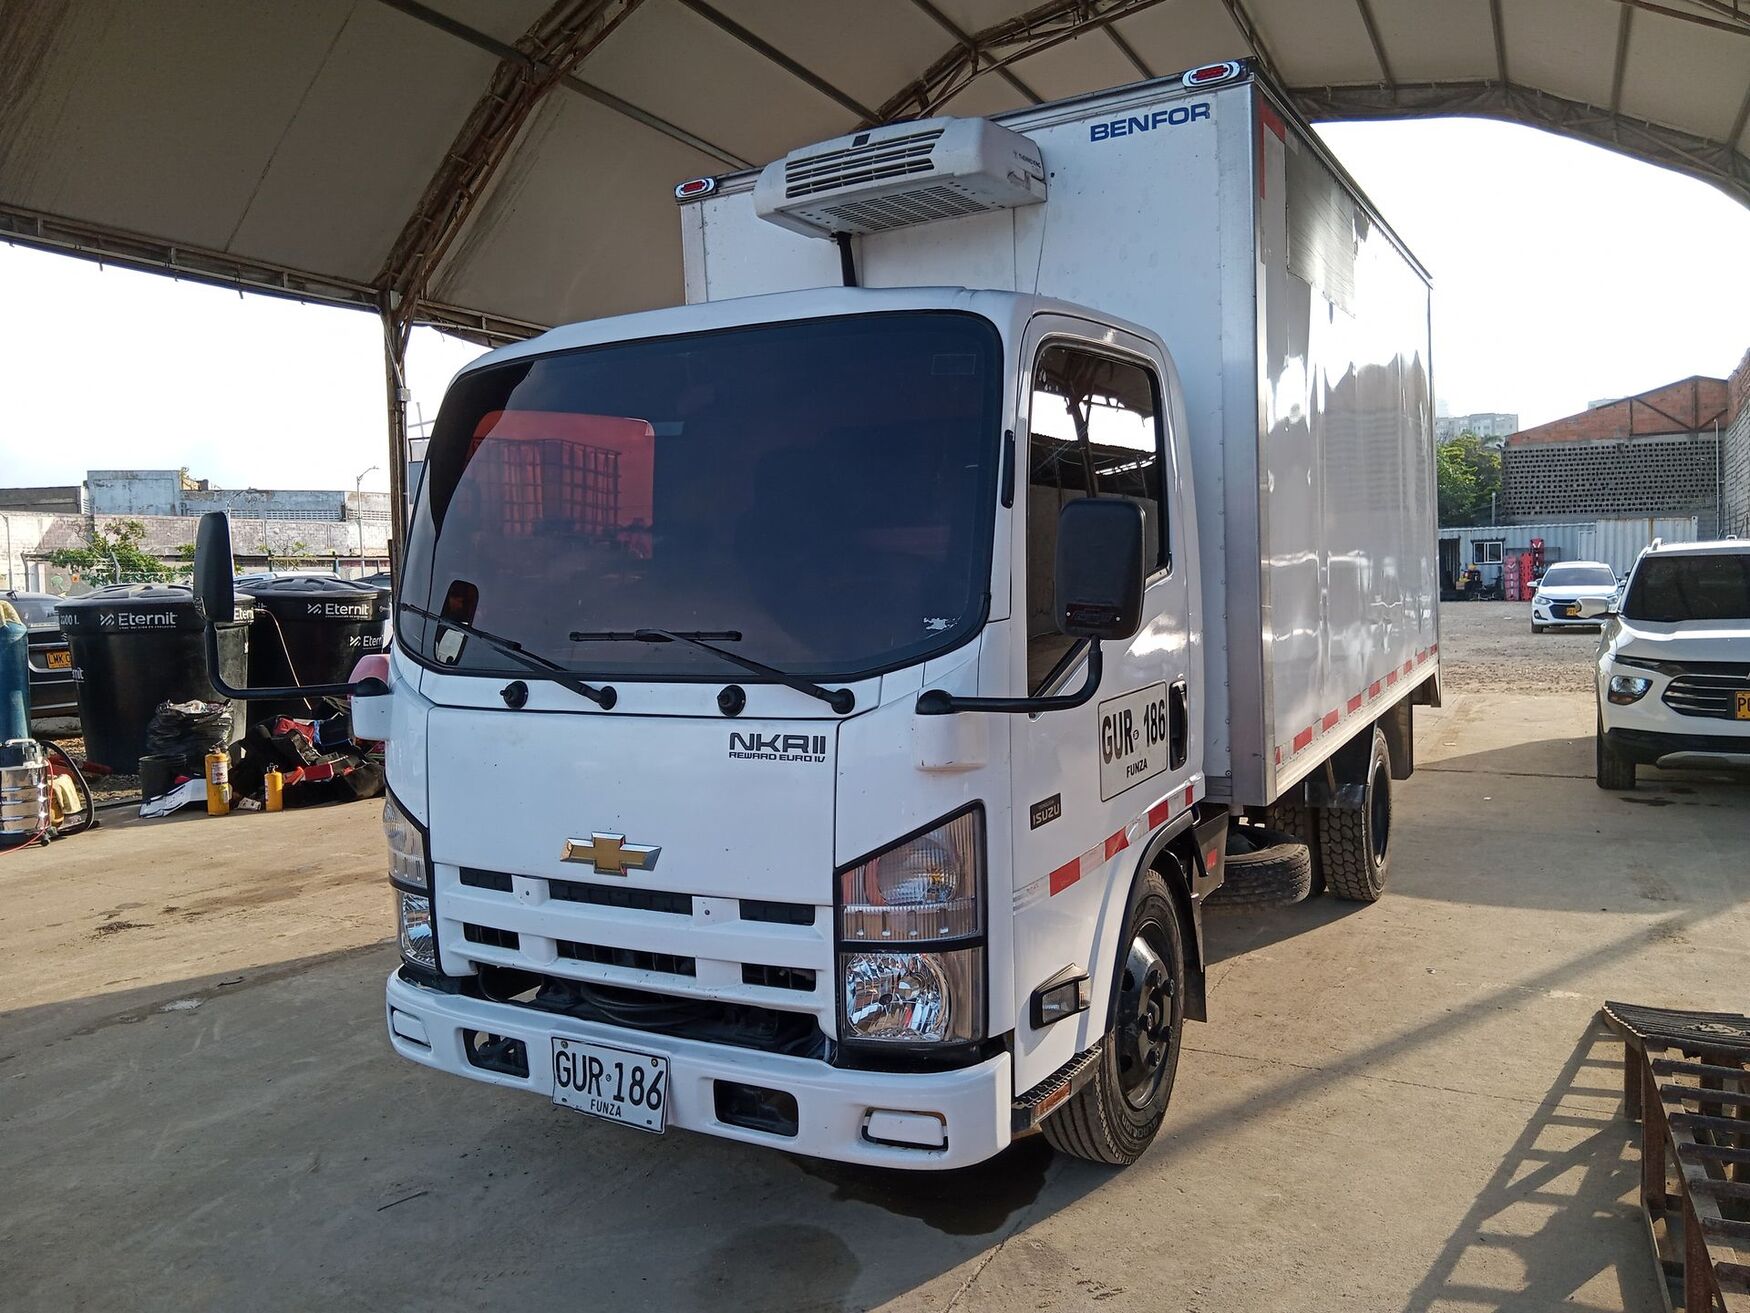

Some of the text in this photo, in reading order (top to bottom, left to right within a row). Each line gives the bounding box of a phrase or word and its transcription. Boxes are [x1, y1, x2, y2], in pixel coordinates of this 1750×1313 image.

[1090, 102, 1211, 142] BENFOR
[118, 611, 178, 626] Eternit
[325, 603, 370, 615] Eternit
[1101, 699, 1166, 765] GUR 186
[728, 751, 777, 760] REWARD
[779, 754, 812, 763] EURO
[1126, 758, 1148, 779] FUNZA
[1032, 803, 1060, 826] ISUZU
[555, 1050, 664, 1111] GUR 186
[590, 1098, 622, 1118] FUNZA
